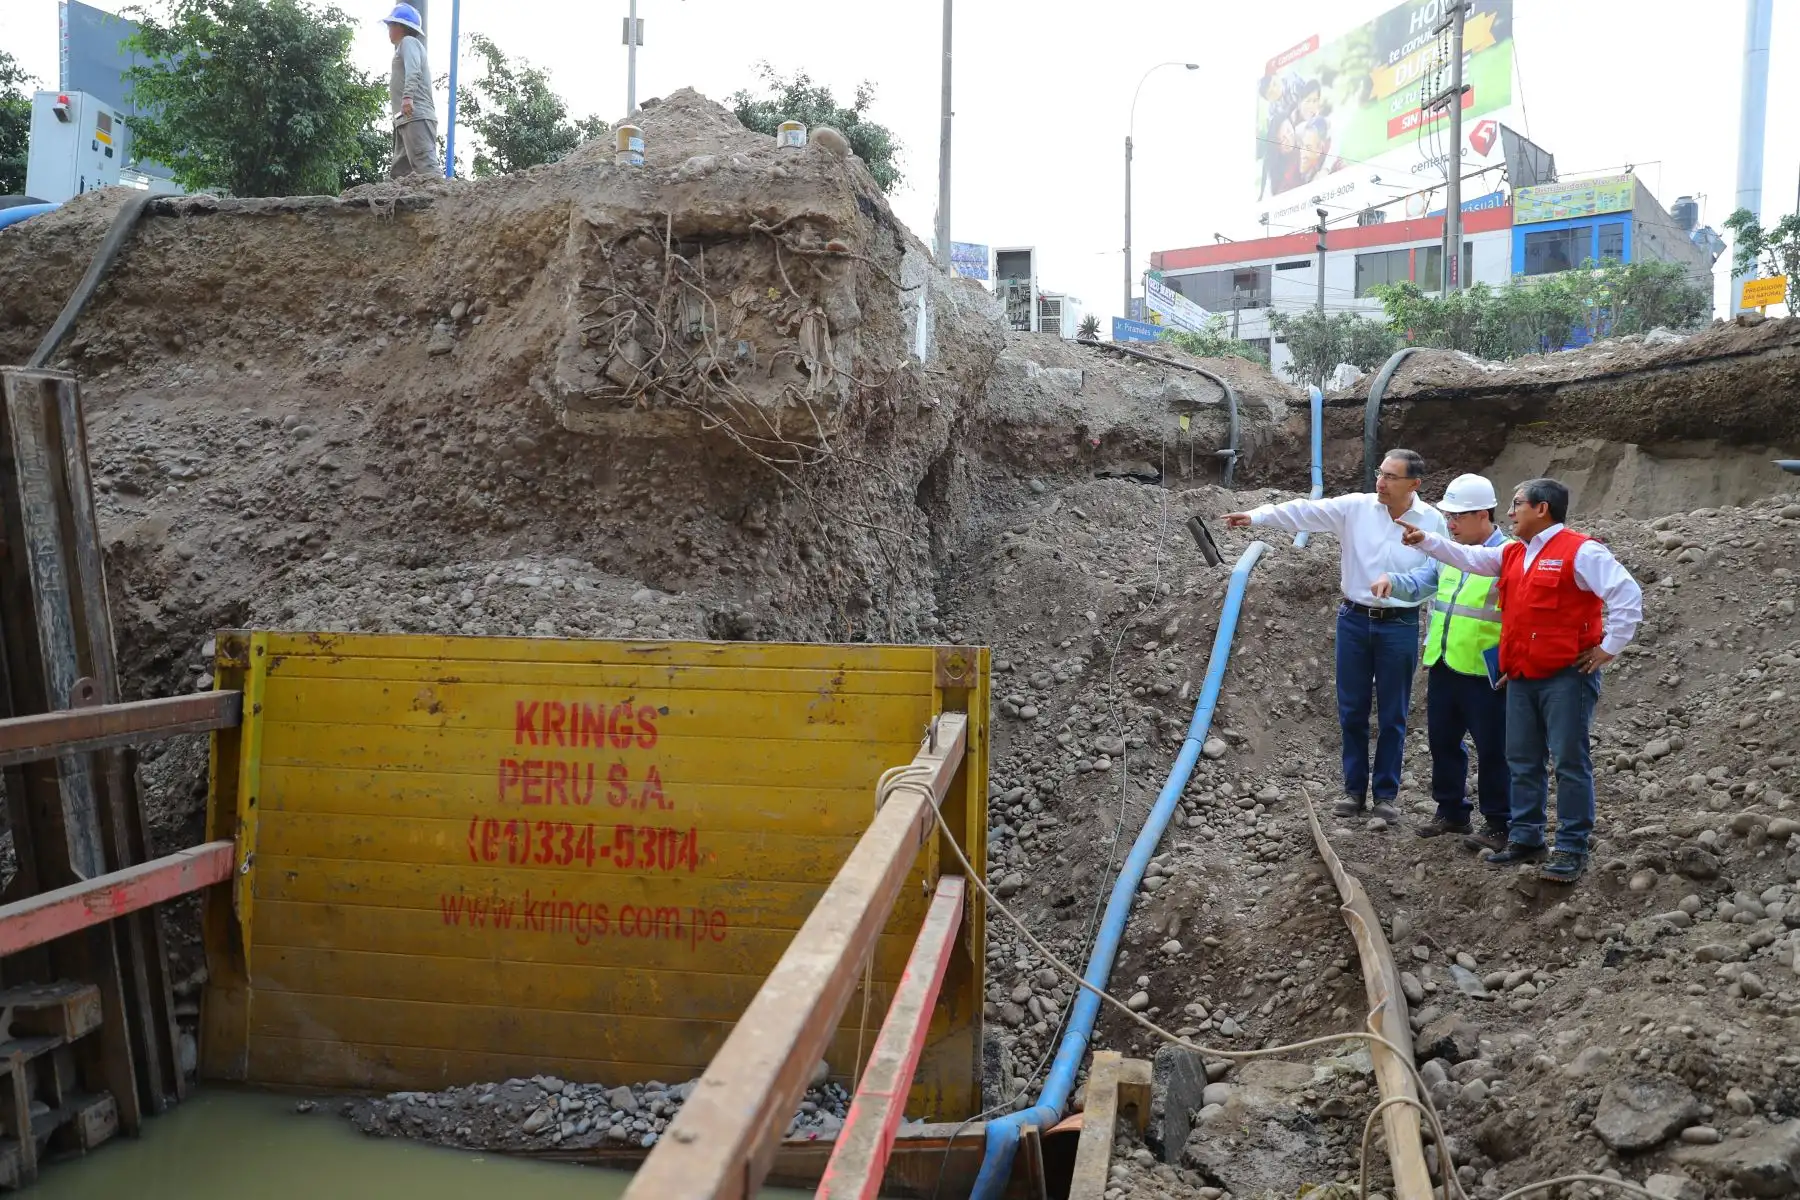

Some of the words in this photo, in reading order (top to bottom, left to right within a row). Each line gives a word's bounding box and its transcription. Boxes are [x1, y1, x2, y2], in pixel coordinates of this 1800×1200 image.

[1389, 48, 1400, 63] te
[1402, 112, 1418, 129] SIN
[515, 700, 658, 750] KRINGS
[498, 758, 595, 806] PERU
[606, 763, 675, 810] S.A.
[467, 815, 699, 872] (01)334-5304
[440, 889, 728, 952] www.krings.com.pe
